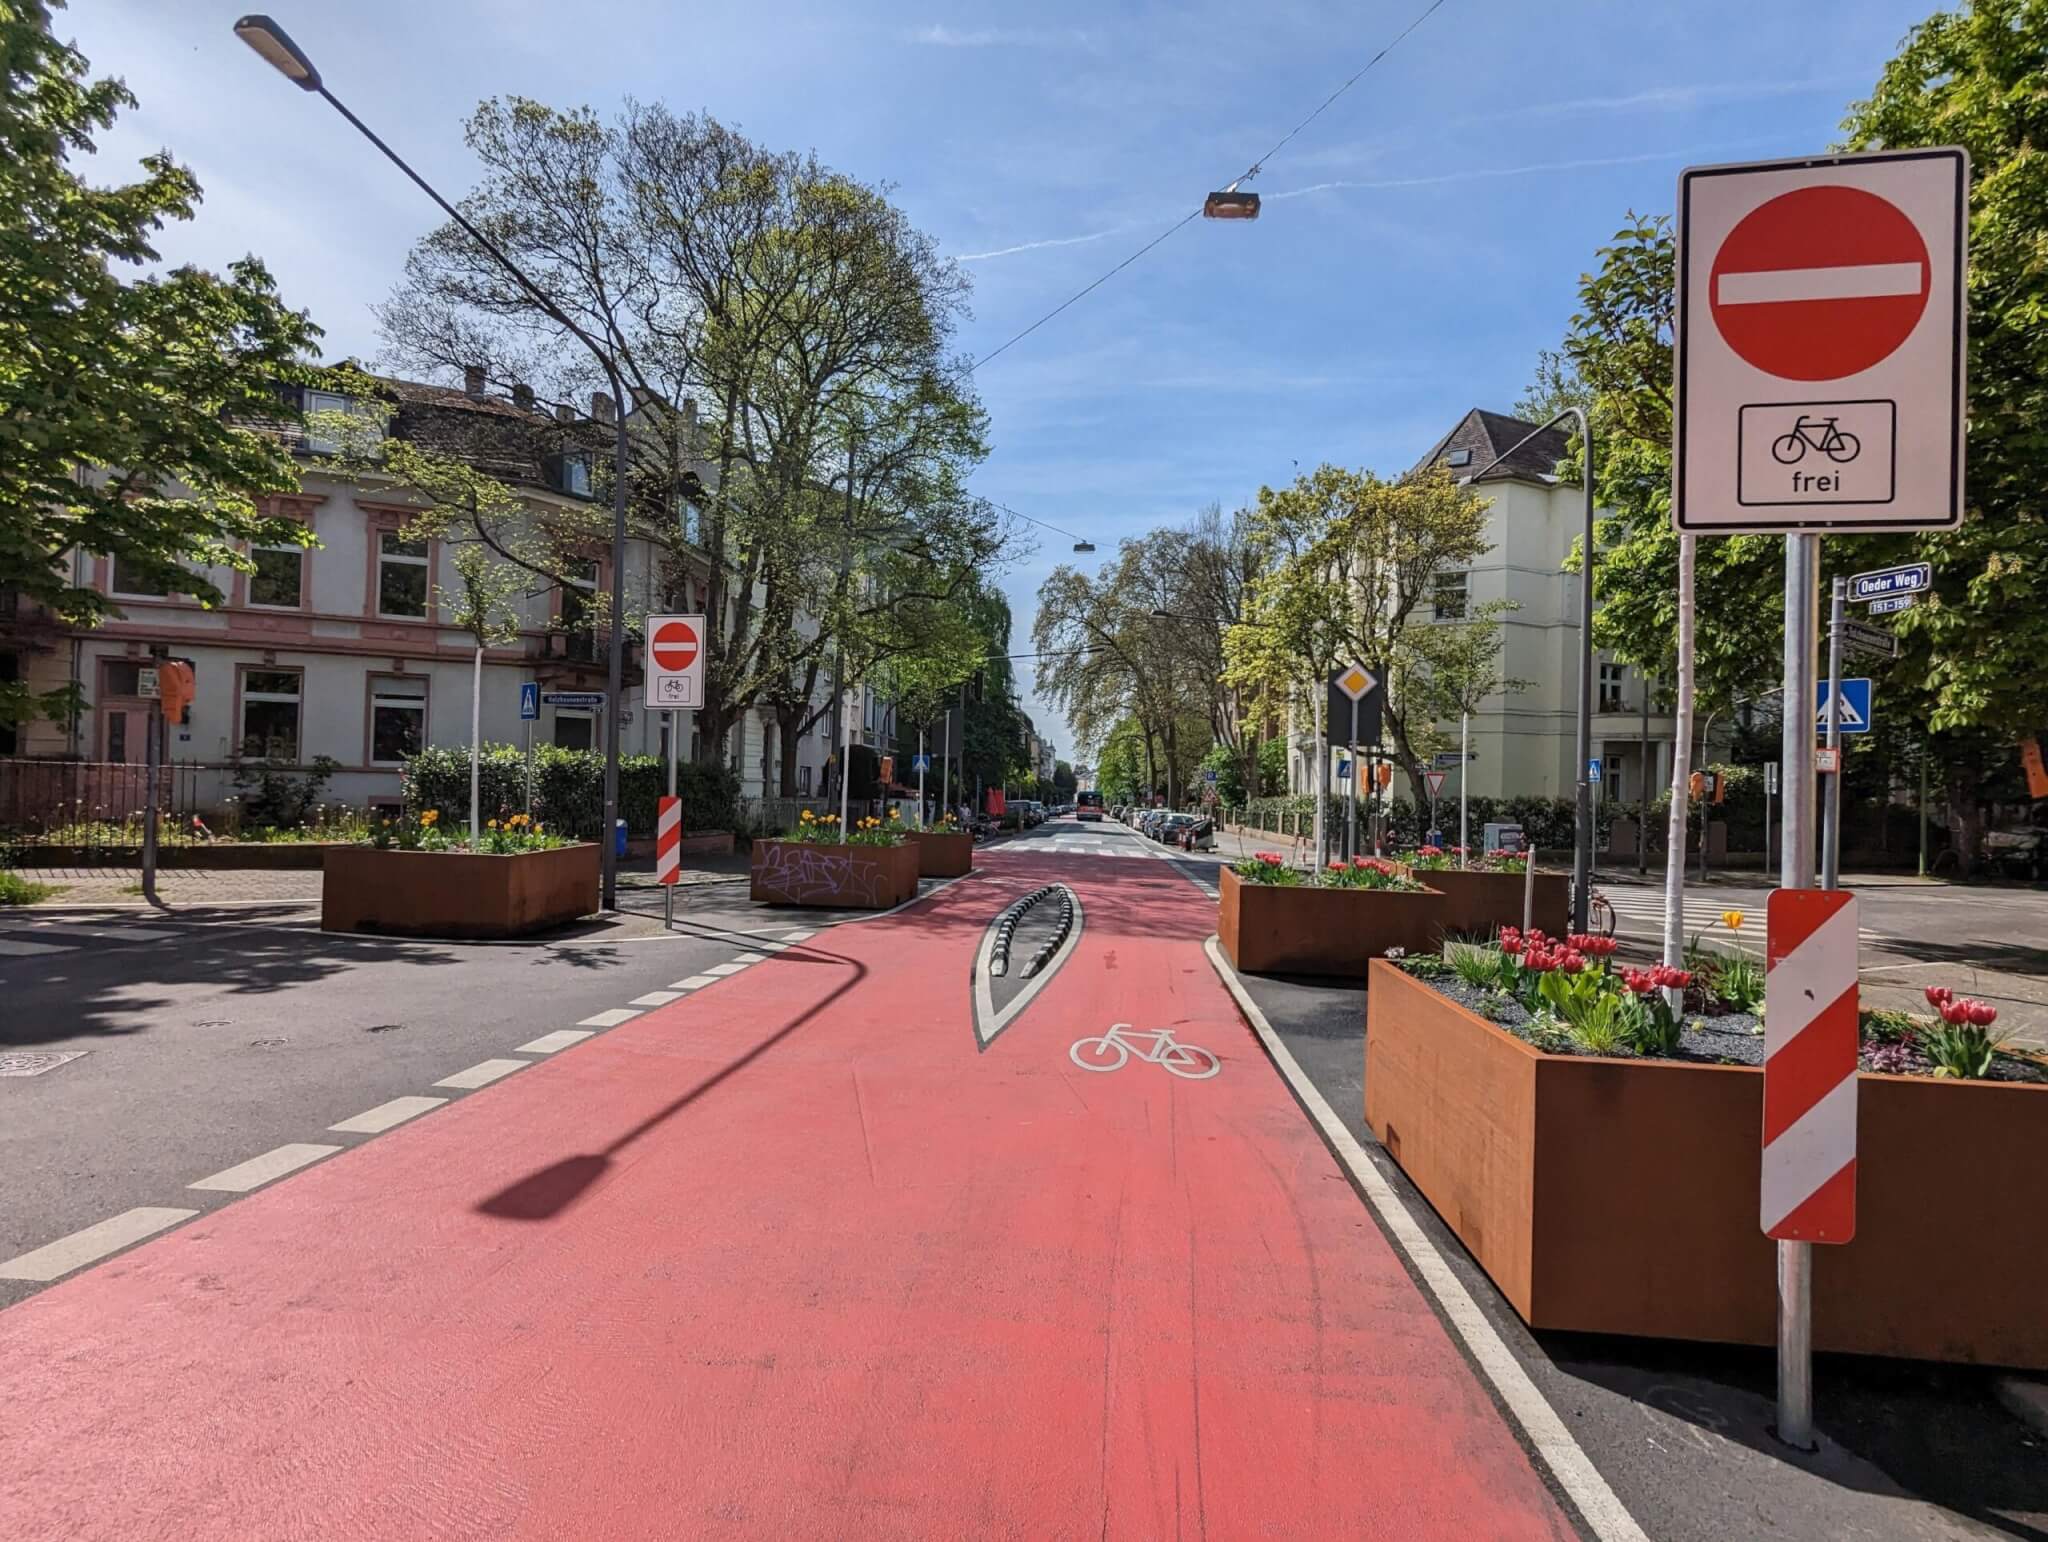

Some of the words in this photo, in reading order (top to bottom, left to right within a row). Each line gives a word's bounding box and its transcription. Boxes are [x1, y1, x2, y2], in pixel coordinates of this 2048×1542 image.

[1792, 470, 1840, 492] frei
[1861, 578, 1891, 593] Oeder
[1895, 573, 1918, 589] Weg
[1873, 600, 1909, 611] 151-159
